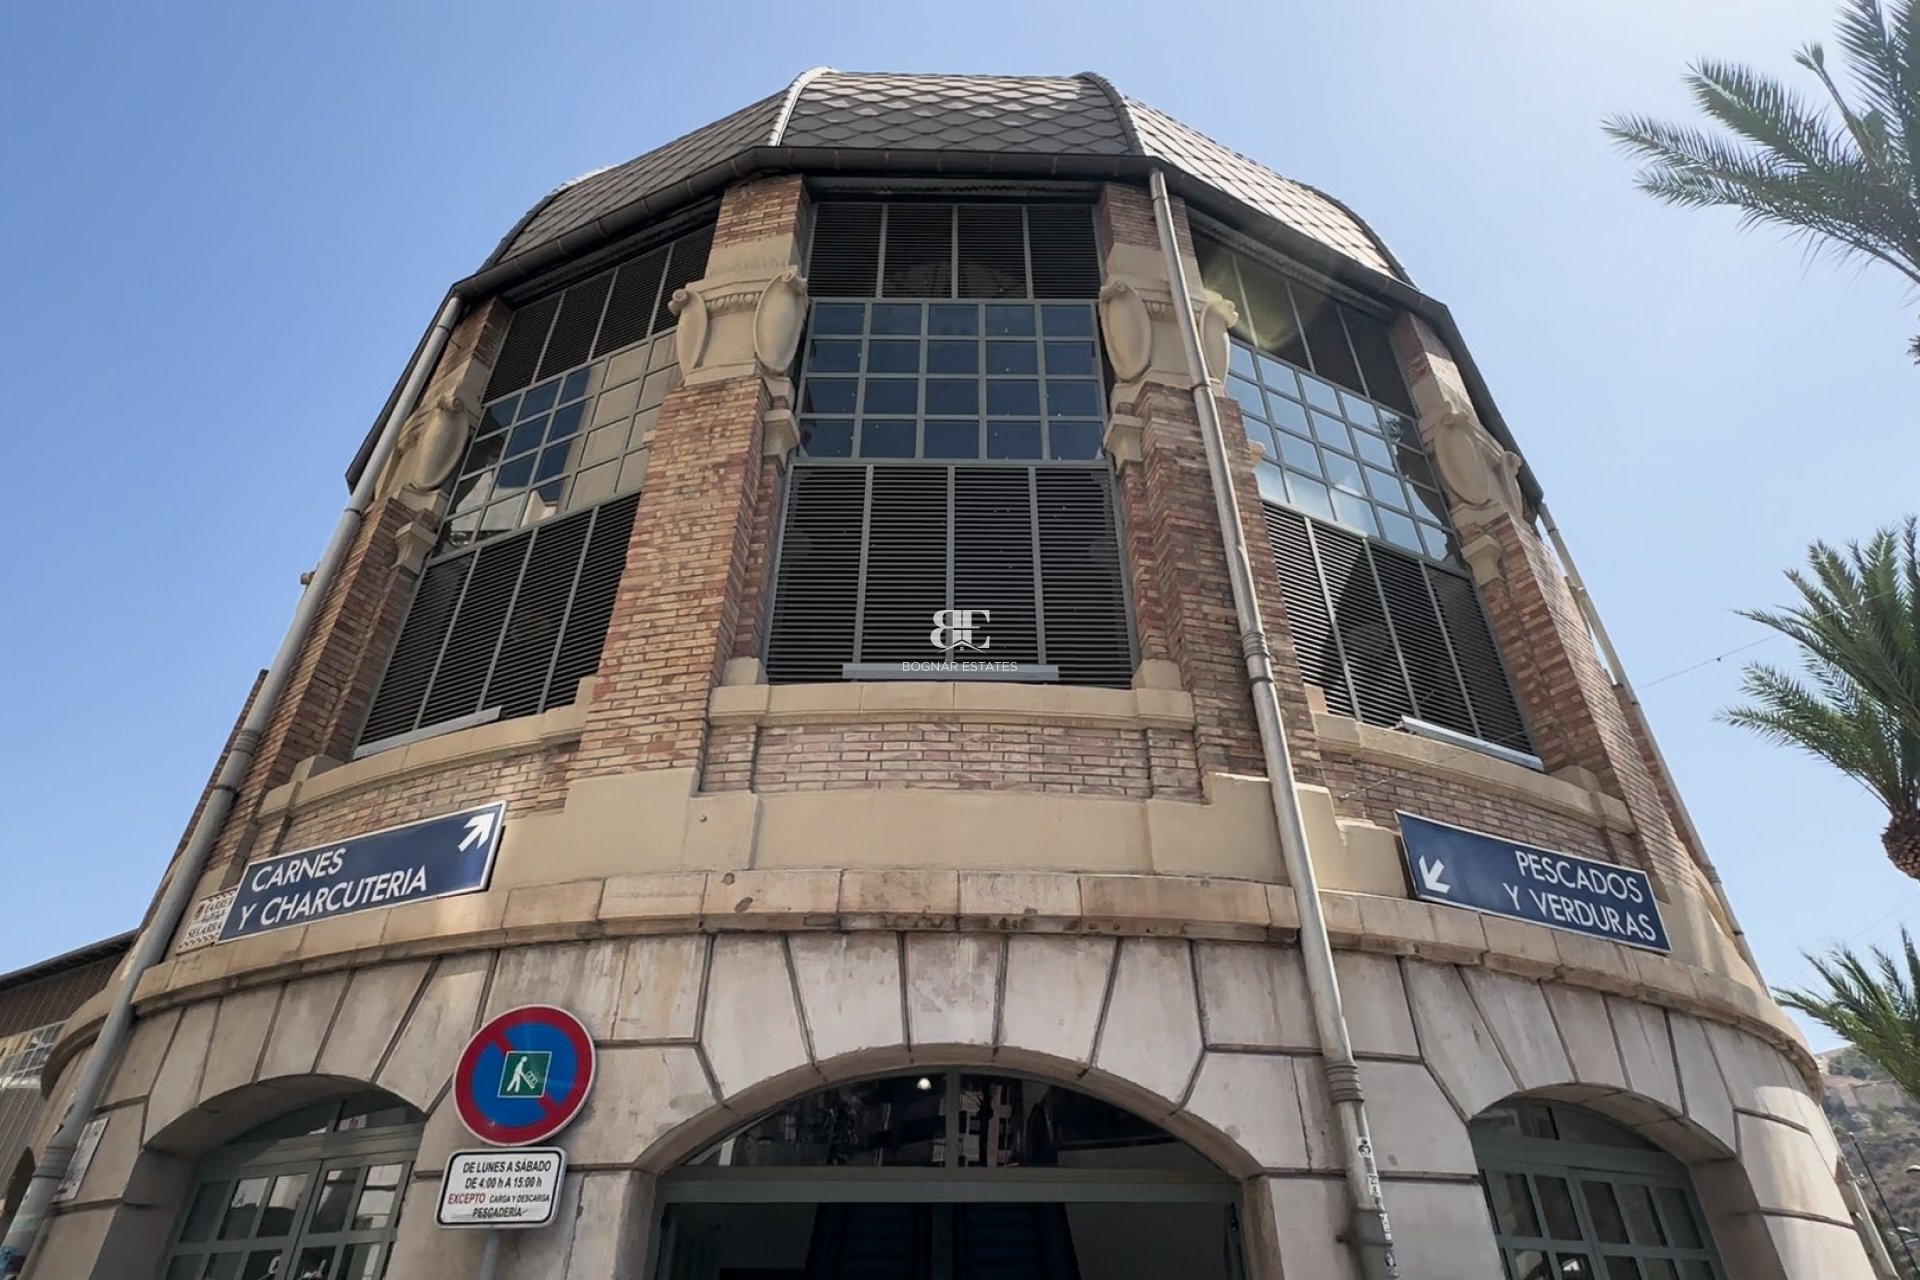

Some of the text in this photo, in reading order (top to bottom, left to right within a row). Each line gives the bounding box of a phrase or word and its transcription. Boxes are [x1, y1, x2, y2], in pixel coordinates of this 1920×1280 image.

[251, 848, 347, 893] CARNES
[1515, 850, 1644, 904] PESCADOS
[238, 865, 428, 931] Y CHARCUTERIA
[1503, 883, 1657, 942] Y VERDURAS
[463, 1158, 552, 1173] DE LUNES A SÁBADO
[465, 1176, 542, 1189] DE 4:00 h A 15:00 h
[448, 1193, 550, 1205] EXCEPTO CARGA Y DESCARGA
